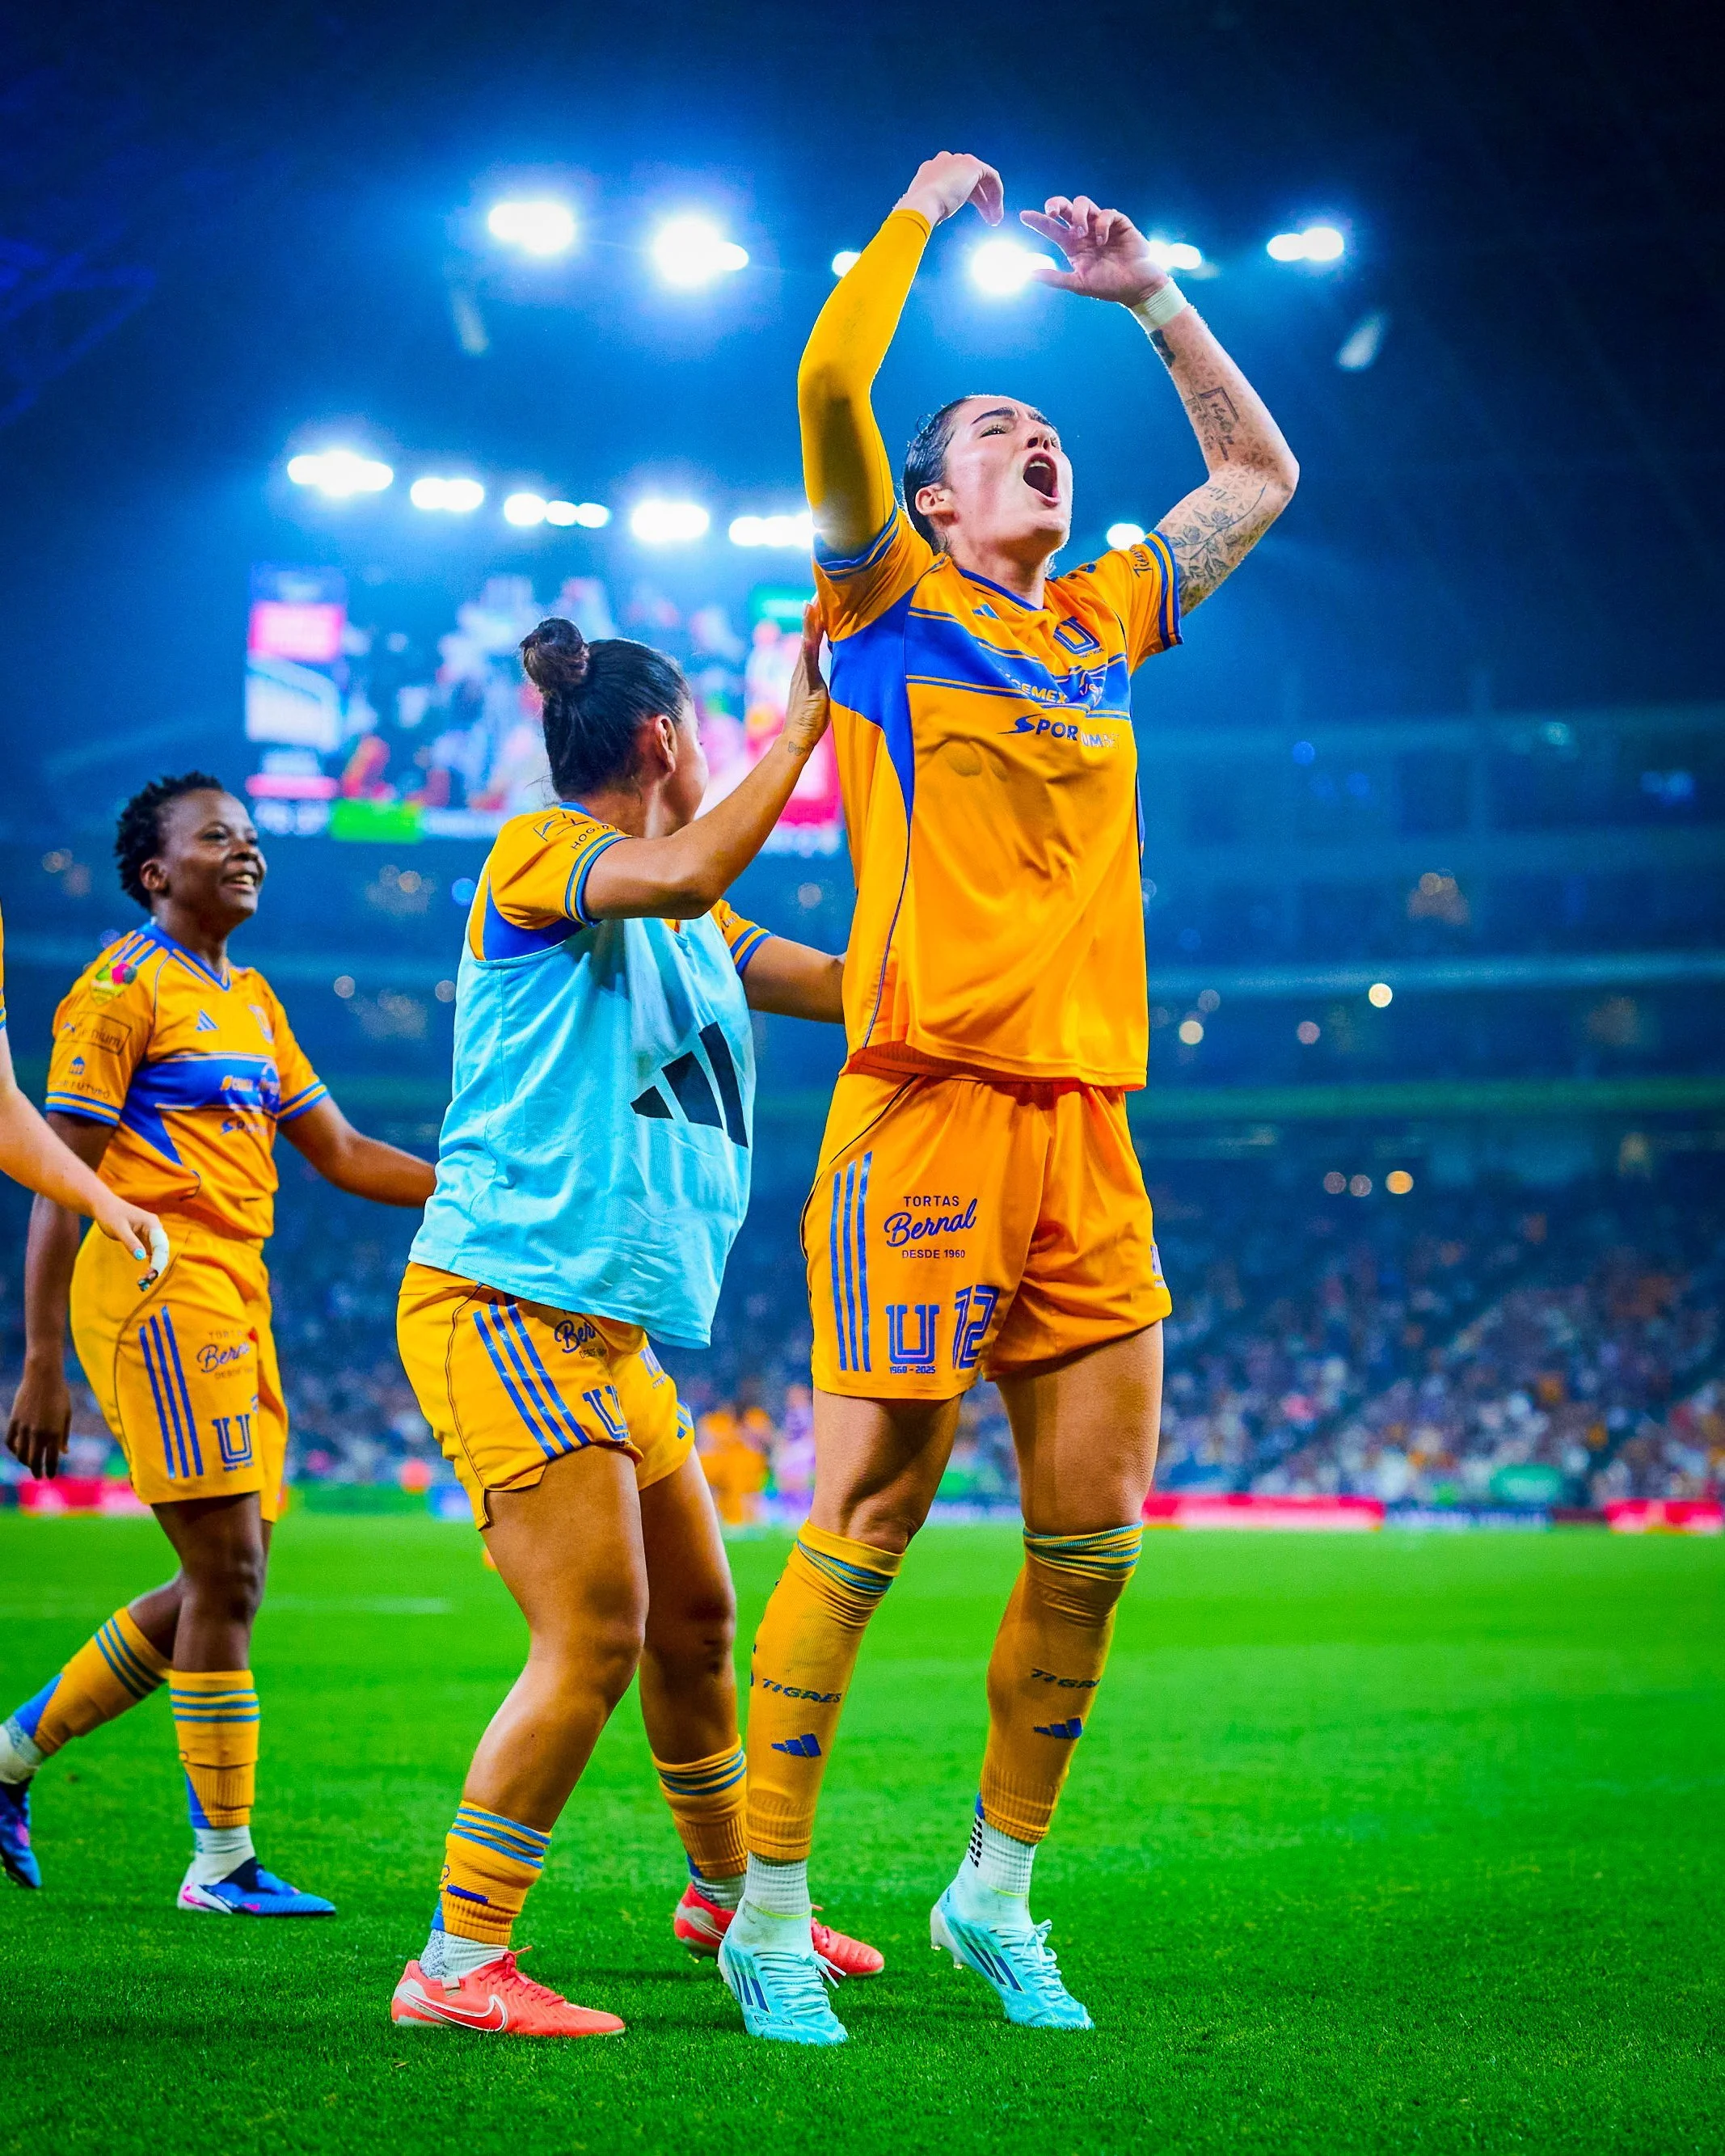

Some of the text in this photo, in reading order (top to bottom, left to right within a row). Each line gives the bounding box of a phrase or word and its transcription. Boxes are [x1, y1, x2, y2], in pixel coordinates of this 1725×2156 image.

[904, 1196, 960, 1207] TORTAS
[884, 1198, 978, 1247] Bernal
[902, 1249, 966, 1259] DESDE 1960
[555, 1319, 596, 1353] Ber
[885, 1304, 940, 1365] U
[952, 1285, 1001, 1370] 12
[212, 1414, 252, 1464] U
[762, 1678, 842, 1703] TIGRES
[1031, 1668, 1101, 1689] TIGR
